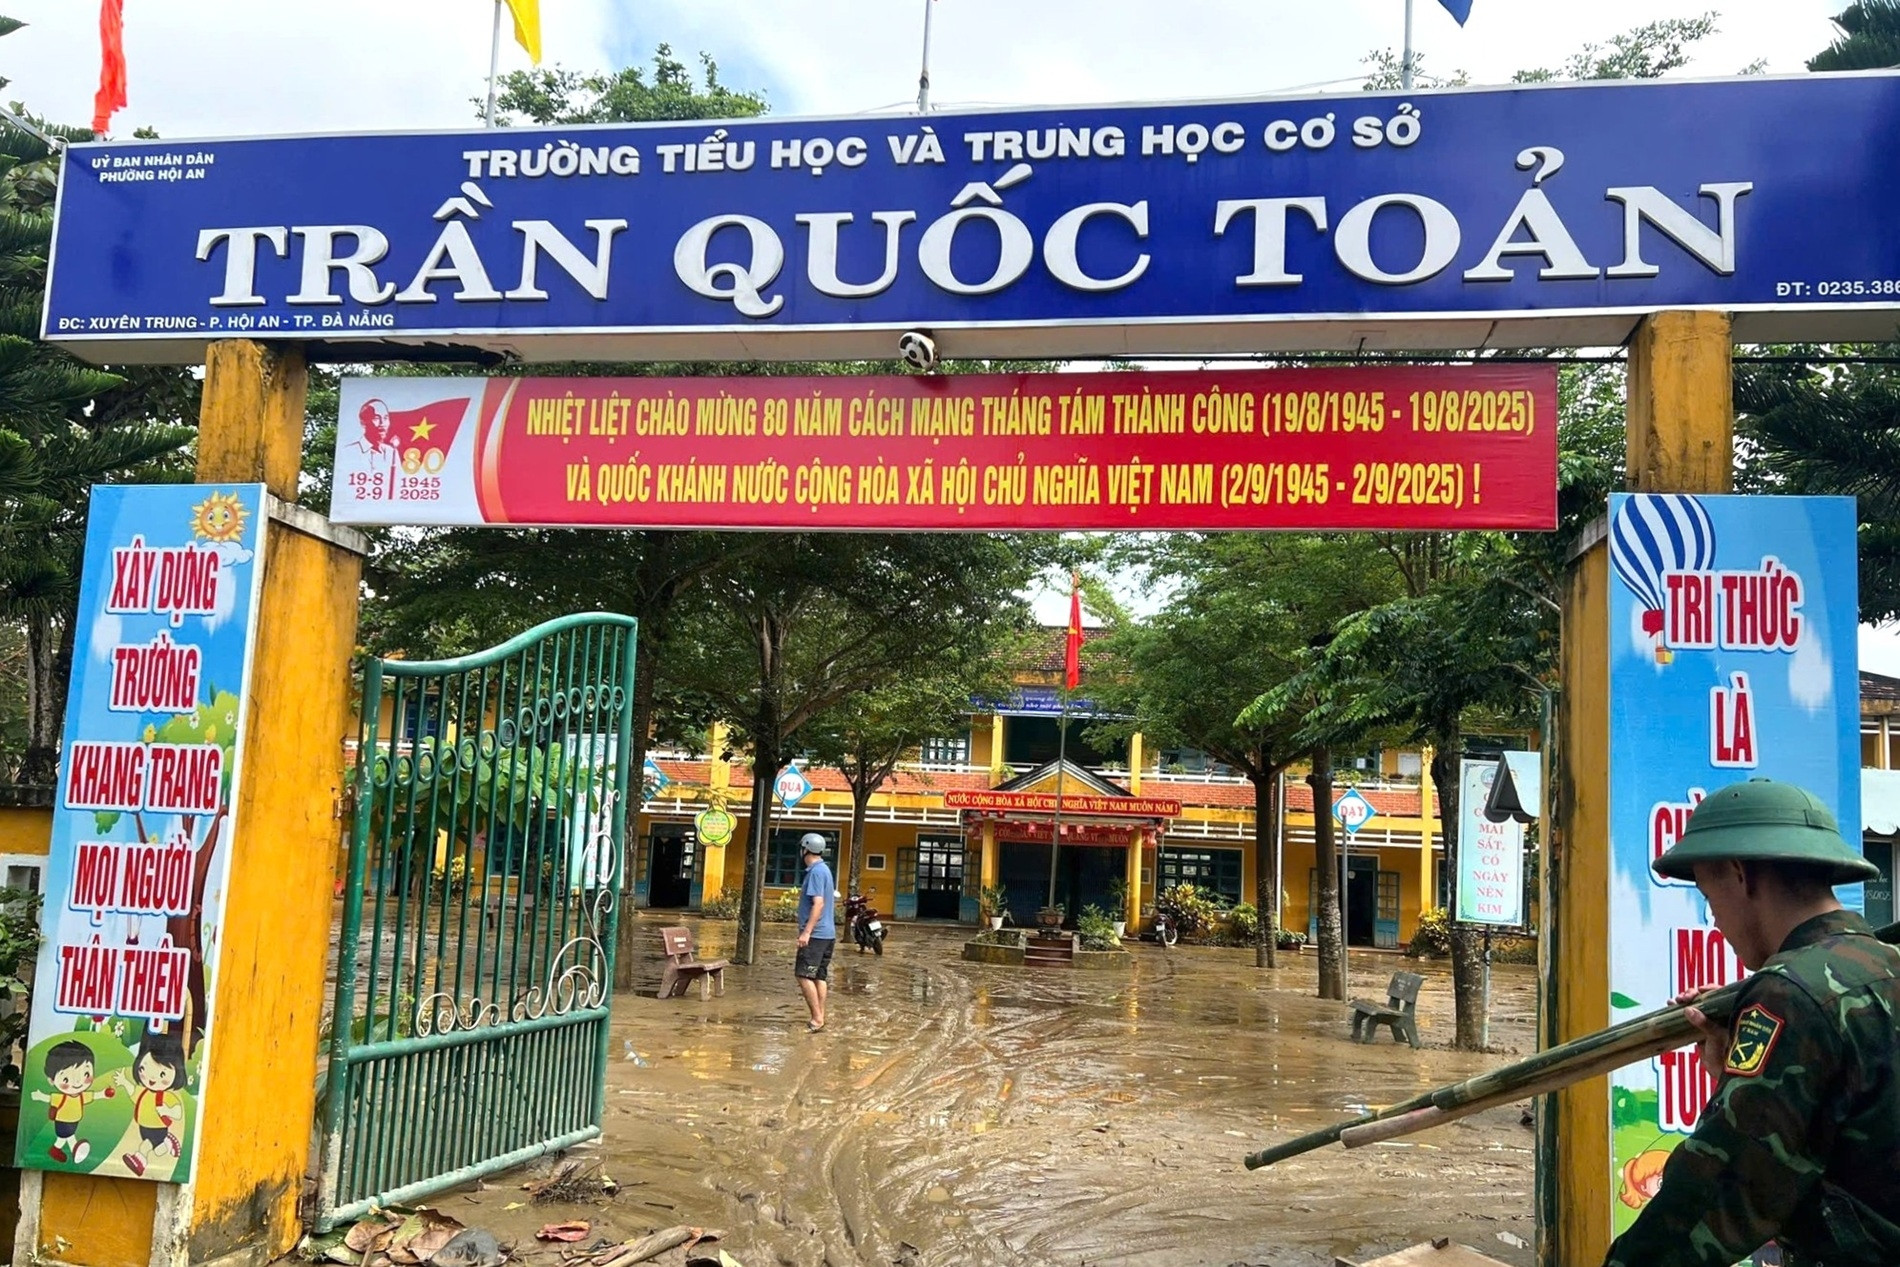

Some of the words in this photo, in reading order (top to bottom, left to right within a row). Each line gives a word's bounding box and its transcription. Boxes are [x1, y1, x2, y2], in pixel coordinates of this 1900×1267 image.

[113, 156, 141, 168] BAN
[143, 152, 183, 166] NHÂN
[185, 151, 215, 165] DÂN
[463, 139, 640, 178] TRƯỜNG
[656, 128, 756, 172] TIỂU
[770, 137, 867, 175] HỌC
[887, 126, 946, 163] VÀ
[964, 126, 1125, 162] TRUNG
[1141, 122, 1245, 162] HỌC
[1264, 112, 1336, 150] CƠ
[1352, 102, 1421, 147] SỞ
[99, 168, 155, 183] PHƯỜNG
[157, 166, 183, 183] HỘI
[185, 168, 205, 180] AN
[195, 181, 628, 306] TRẦN
[673, 163, 1152, 320] QUỐC
[1212, 145, 1754, 286] TOẢN
[1776, 282, 1811, 296] ĐT:
[58, 317, 85, 330] ĐC:
[88, 314, 141, 330] XUYÊN
[209, 316, 223, 329] P.
[227, 312, 257, 333] HỘI
[258, 315, 280, 328] AN
[293, 315, 316, 327] TP.
[321, 311, 344, 327] ĐÀ
[348, 309, 394, 327] NẴNG
[526, 396, 586, 444] NHIỆT
[589, 396, 631, 443] LIỆT
[635, 391, 690, 437] CHÀO
[694, 390, 757, 437] MỪNG
[762, 397, 789, 437] 80
[793, 392, 843, 437] NĂM
[847, 390, 904, 437] CÁCH
[910, 396, 975, 445] MẠNG
[981, 389, 1052, 436] THÁNG
[1058, 388, 1105, 435] TÁM
[1112, 386, 1185, 434] THÀNH
[1192, 384, 1255, 434] CÔNG
[1262, 391, 1385, 437] (19/8/1945
[1409, 390, 1535, 436] 19/8/2025)
[348, 472, 384, 486] 19-8
[400, 476, 441, 488] 1945
[402, 447, 444, 475] 80
[566, 455, 591, 502] VÀ
[596, 451, 652, 505] QUỐC
[656, 455, 728, 503] KHÁNH
[731, 452, 790, 504] NƯỚC
[794, 457, 853, 513] CỘNG
[858, 455, 900, 505] HÒA
[905, 457, 935, 505] XÃ
[940, 457, 977, 514] HỘI
[983, 452, 1028, 506] CHỦ
[1032, 457, 1100, 505] NGHĨA
[1107, 456, 1155, 514] VIỆT
[1159, 463, 1214, 504] NAM
[1220, 462, 1329, 509] (2/9/1945
[355, 486, 383, 500] 2-9
[399, 488, 440, 500] 2025
[110, 539, 156, 608] XÂY
[157, 545, 219, 623] DỰNG
[1667, 574, 1713, 643] TRI
[1721, 560, 1799, 646] THỨC
[113, 633, 198, 708] TRƯỜNG
[1715, 676, 1753, 762] LÀ
[68, 745, 144, 806] KHANG
[148, 747, 220, 809] TRANG
[948, 792, 971, 804] NƯỚC
[972, 793, 994, 807] CỘNG
[995, 794, 1013, 806] HÒA
[1026, 796, 1041, 809] HỘI
[1062, 798, 1088, 809] NGHĨA
[1089, 798, 1108, 811] VIỆT
[1109, 801, 1128, 812] NAM
[1129, 801, 1154, 813] MUÔN
[1155, 801, 1174, 814] NĂM
[73, 845, 120, 920] MỌI
[121, 833, 193, 911] NGƯỜI
[1477, 902, 1503, 915] KIM
[59, 933, 118, 1010] THÂN
[121, 937, 187, 1028] THIỆN
